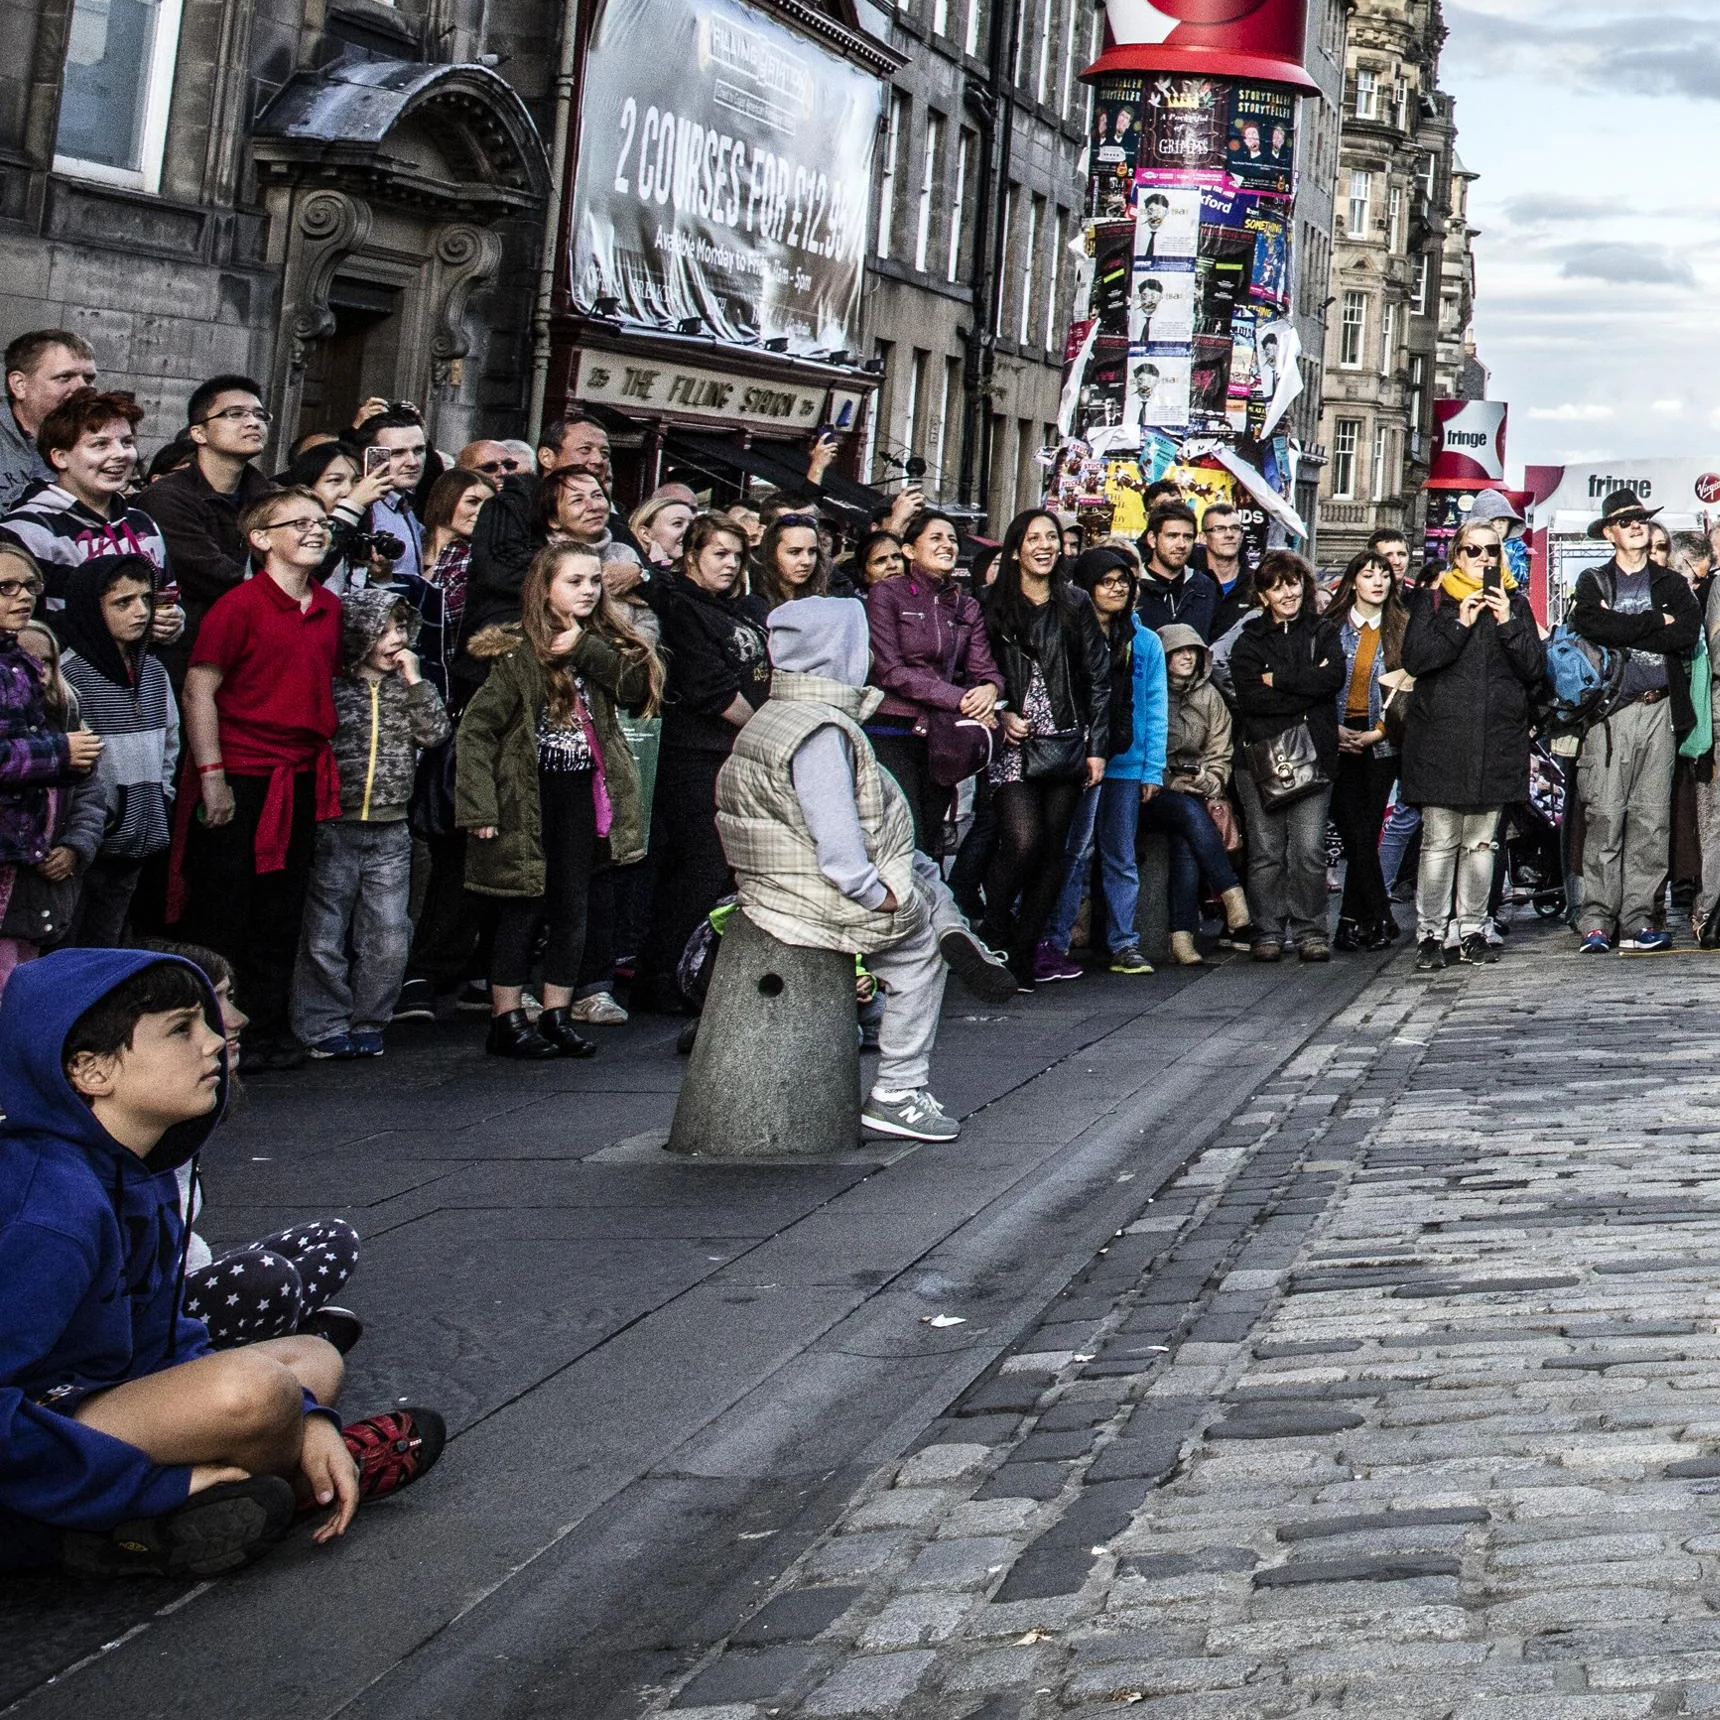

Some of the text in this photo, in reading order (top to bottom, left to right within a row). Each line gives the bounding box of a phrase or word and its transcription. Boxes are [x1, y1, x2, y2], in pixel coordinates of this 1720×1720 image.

[614, 96, 637, 194] 2
[638, 105, 746, 228] COURSES
[746, 147, 789, 242] FOR
[697, 238, 734, 274] Monday
[734, 251, 746, 272] to
[620, 366, 661, 400] THE
[667, 374, 734, 409] FILLING
[1447, 430, 1487, 448] fringe
